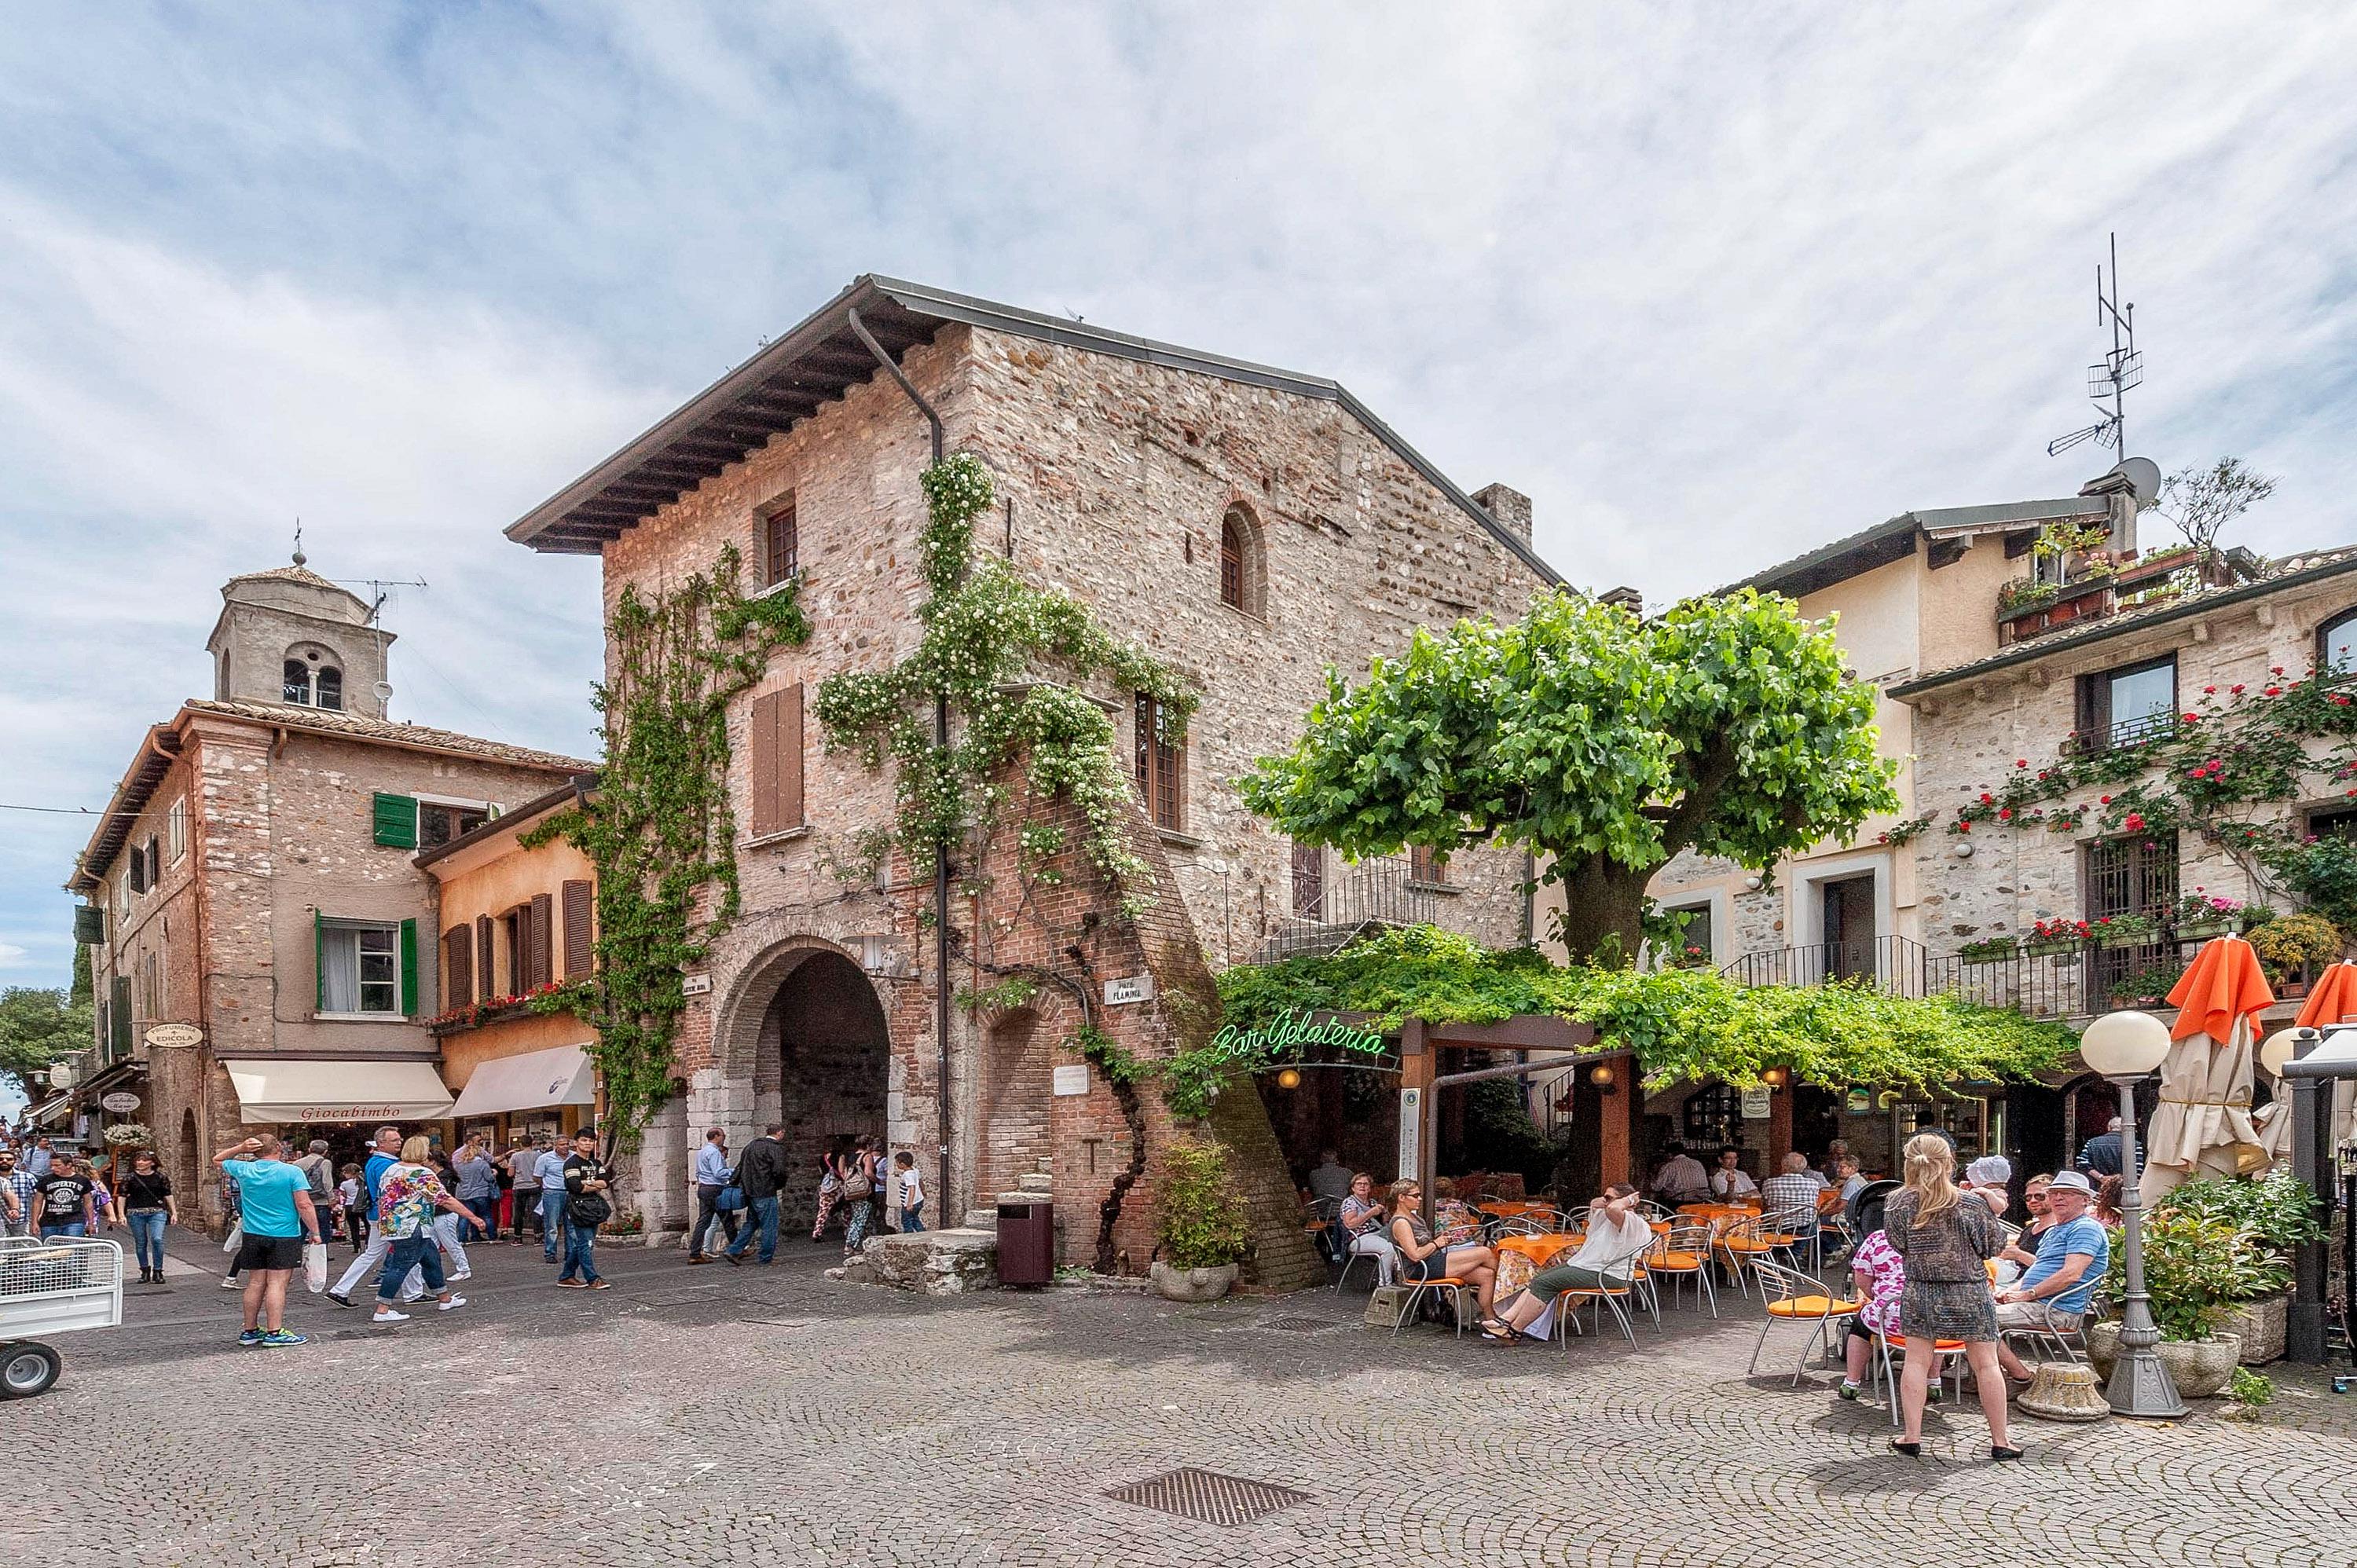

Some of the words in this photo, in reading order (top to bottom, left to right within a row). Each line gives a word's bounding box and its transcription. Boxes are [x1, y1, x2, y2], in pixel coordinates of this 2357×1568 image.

[150, 1025, 196, 1034] PROFUMERIA
[1212, 1024, 1265, 1061] Bar
[1267, 1009, 1385, 1055] Gelateria
[301, 1105, 400, 1121] Giocabimbo
[46, 1181, 77, 1191] PROPERTY
